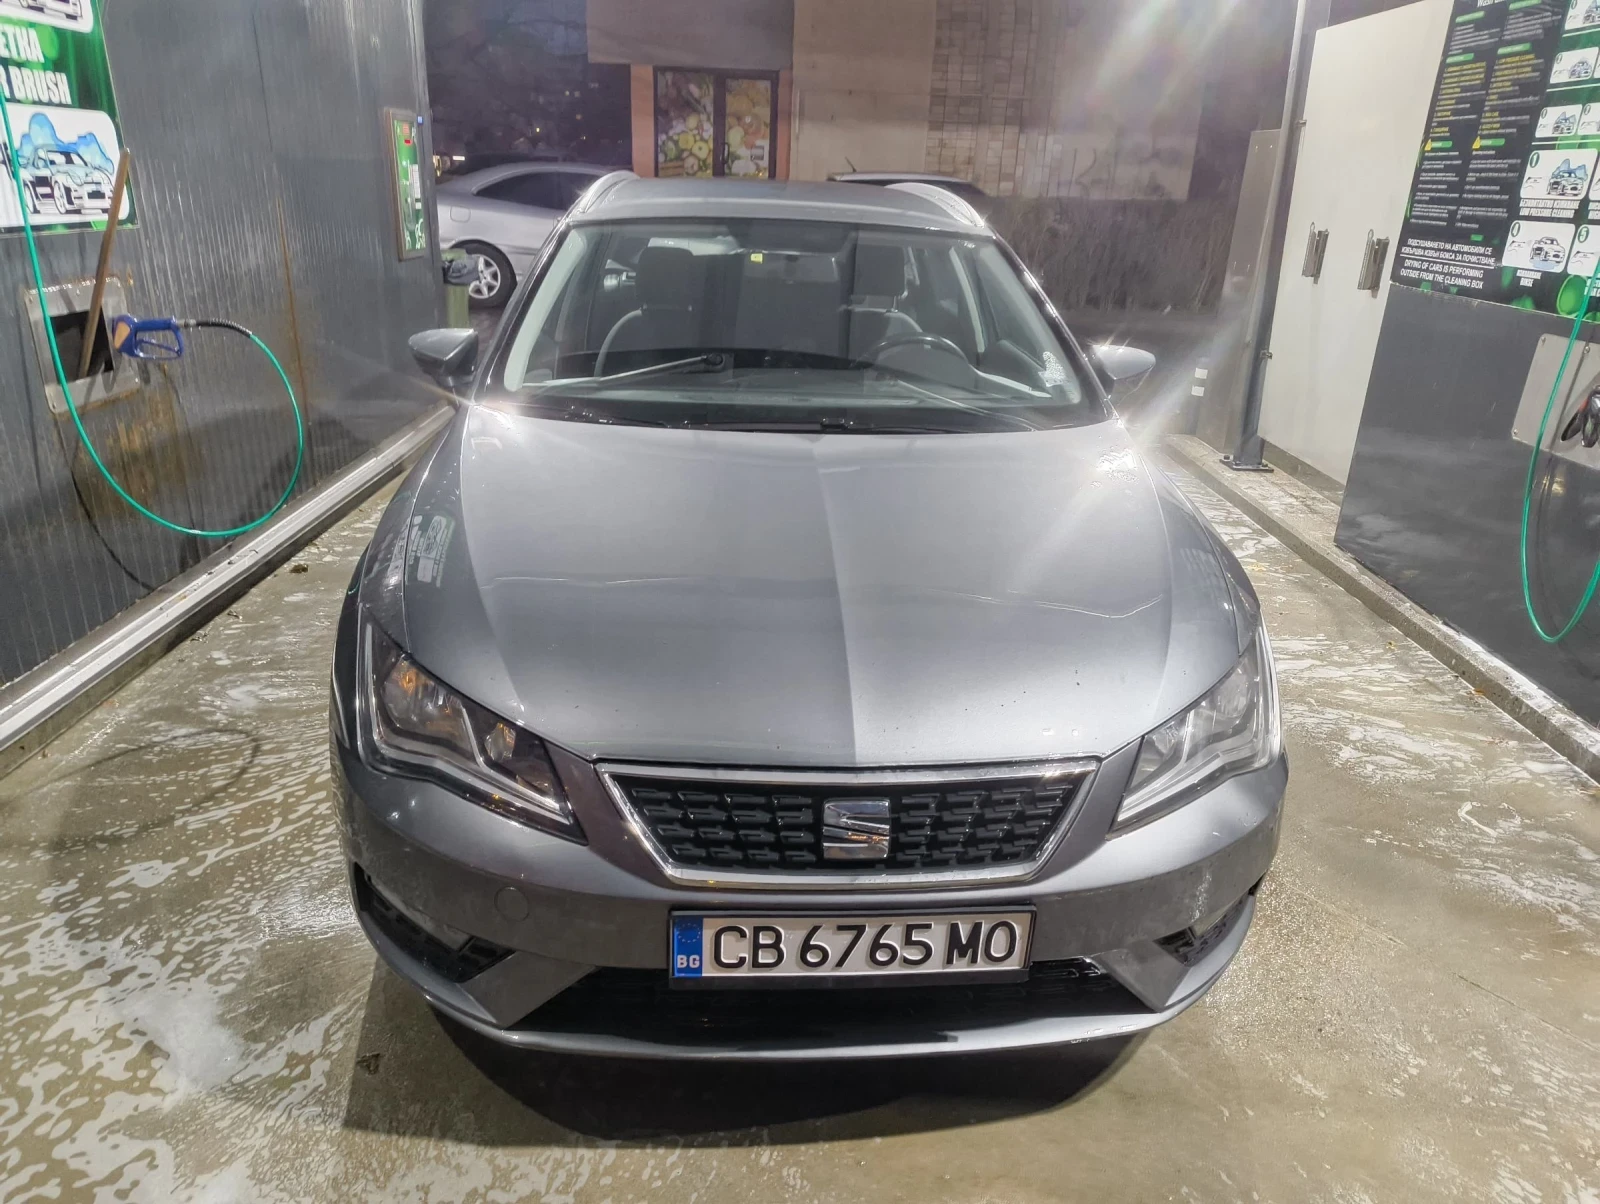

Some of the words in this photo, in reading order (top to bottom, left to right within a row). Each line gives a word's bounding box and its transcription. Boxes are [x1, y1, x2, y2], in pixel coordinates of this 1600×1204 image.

[8, 65, 72, 105] BRUSH
[1440, 251, 1455, 260] БОКСА
[1455, 253, 1463, 261] ЗА
[1462, 254, 1496, 265] ПОЧИСТВАНЕ
[1444, 242, 1452, 250] НА
[1451, 243, 1485, 253] АВТОМОБИЛИ
[1485, 247, 1493, 255] СЕ
[1404, 259, 1421, 269] DRYING
[1421, 261, 1429, 270] OF
[1429, 262, 1443, 272] CARS
[1442, 265, 1449, 273] IS
[1449, 266, 1484, 278] PERFORMING
[1400, 268, 1420, 278] OUTSIDE
[1420, 271, 1434, 281] FROM
[1434, 274, 1444, 283] THE
[1444, 276, 1470, 286] CLEANING
[1470, 280, 1484, 289] BOX
[713, 924, 787, 969] CB
[799, 922, 935, 968] 6765
[946, 920, 1019, 965] MO
[676, 954, 700, 969] BG
